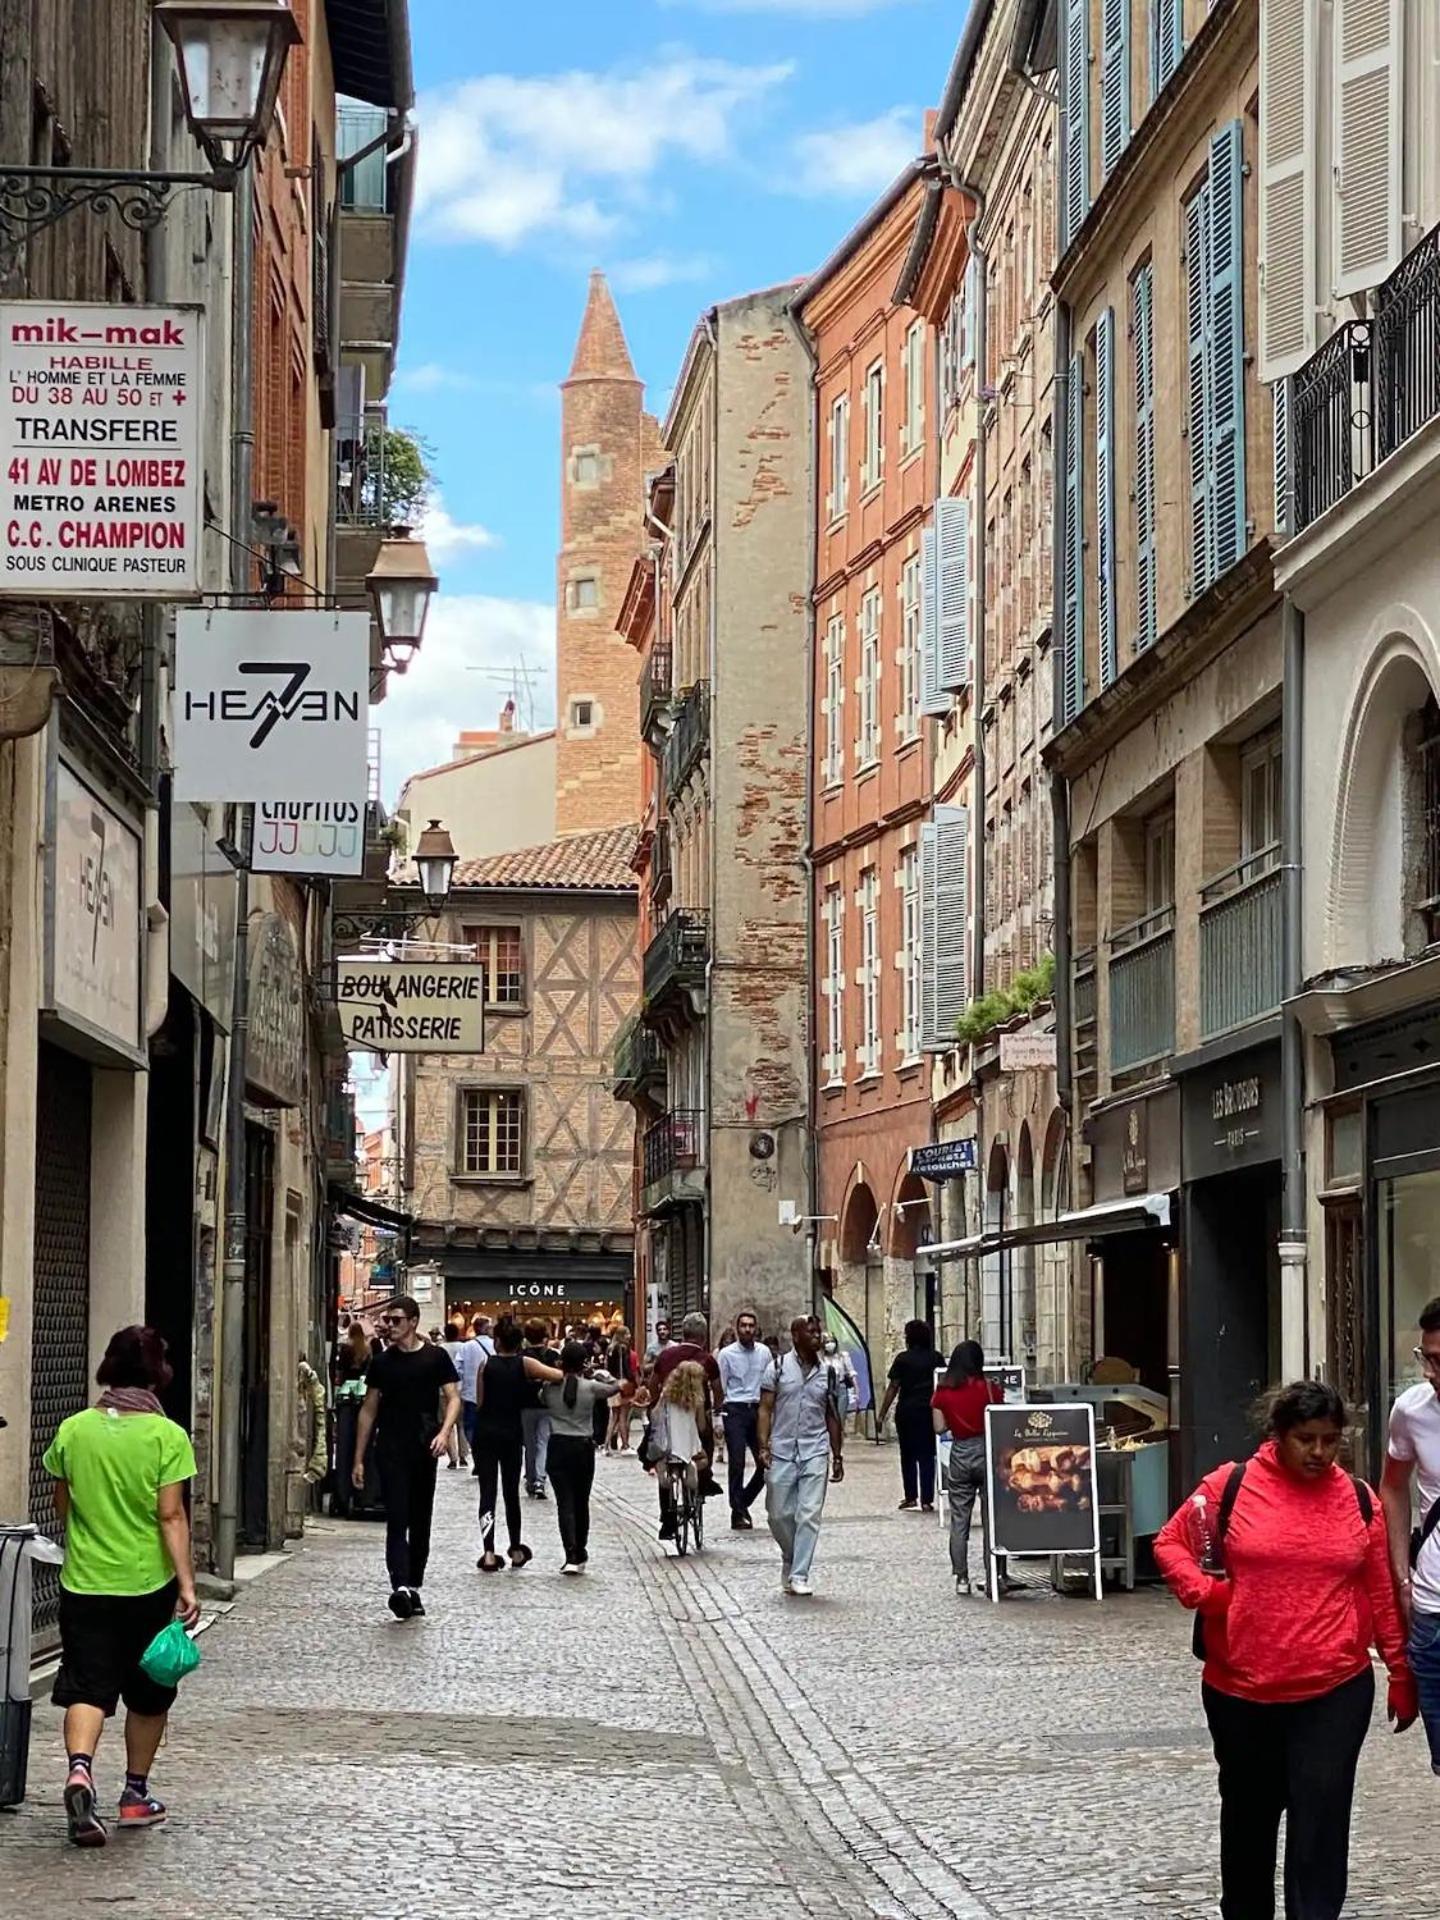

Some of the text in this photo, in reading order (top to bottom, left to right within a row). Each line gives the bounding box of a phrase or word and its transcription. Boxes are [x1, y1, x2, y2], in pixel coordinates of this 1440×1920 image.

[50, 356, 153, 370] HABILLE
[27, 371, 82, 385] HOMME
[87, 372, 106, 385] ET
[111, 373, 130, 386] LA
[135, 373, 187, 387] FEMME
[12, 386, 39, 404] DU
[48, 387, 73, 405] 38
[82, 388, 108, 406] AU
[117, 389, 142, 406] 50
[150, 392, 164, 406] ET
[15, 418, 178, 442] TRANSFERE
[8, 457, 186, 488] 41 AV DE LOMBEZ
[13, 495, 176, 513] METRO ARENES
[58, 520, 185, 550] CHAMPION
[6, 556, 186, 573] SOUS CLINIQUE PASTEUR
[352, 1015, 462, 1040] PATISSERIE
